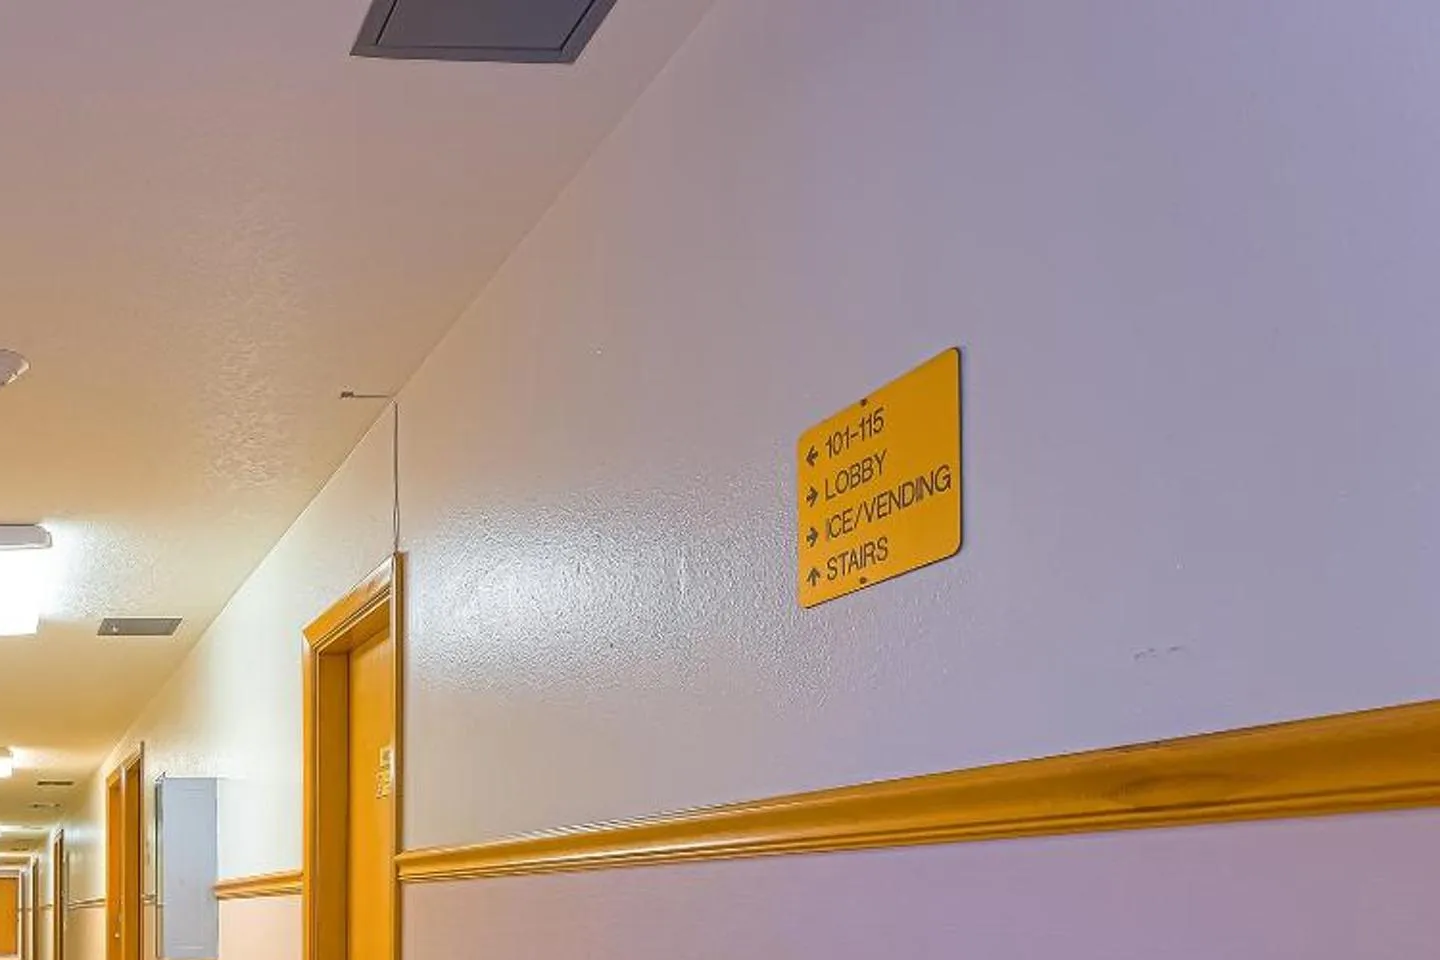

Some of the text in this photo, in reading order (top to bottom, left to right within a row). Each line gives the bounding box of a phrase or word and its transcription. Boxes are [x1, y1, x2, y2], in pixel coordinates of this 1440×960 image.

[825, 407, 885, 459] 101-115
[824, 448, 888, 501] LOBBY
[825, 464, 952, 540] ICE/VENDING
[826, 536, 889, 582] STAIRS
